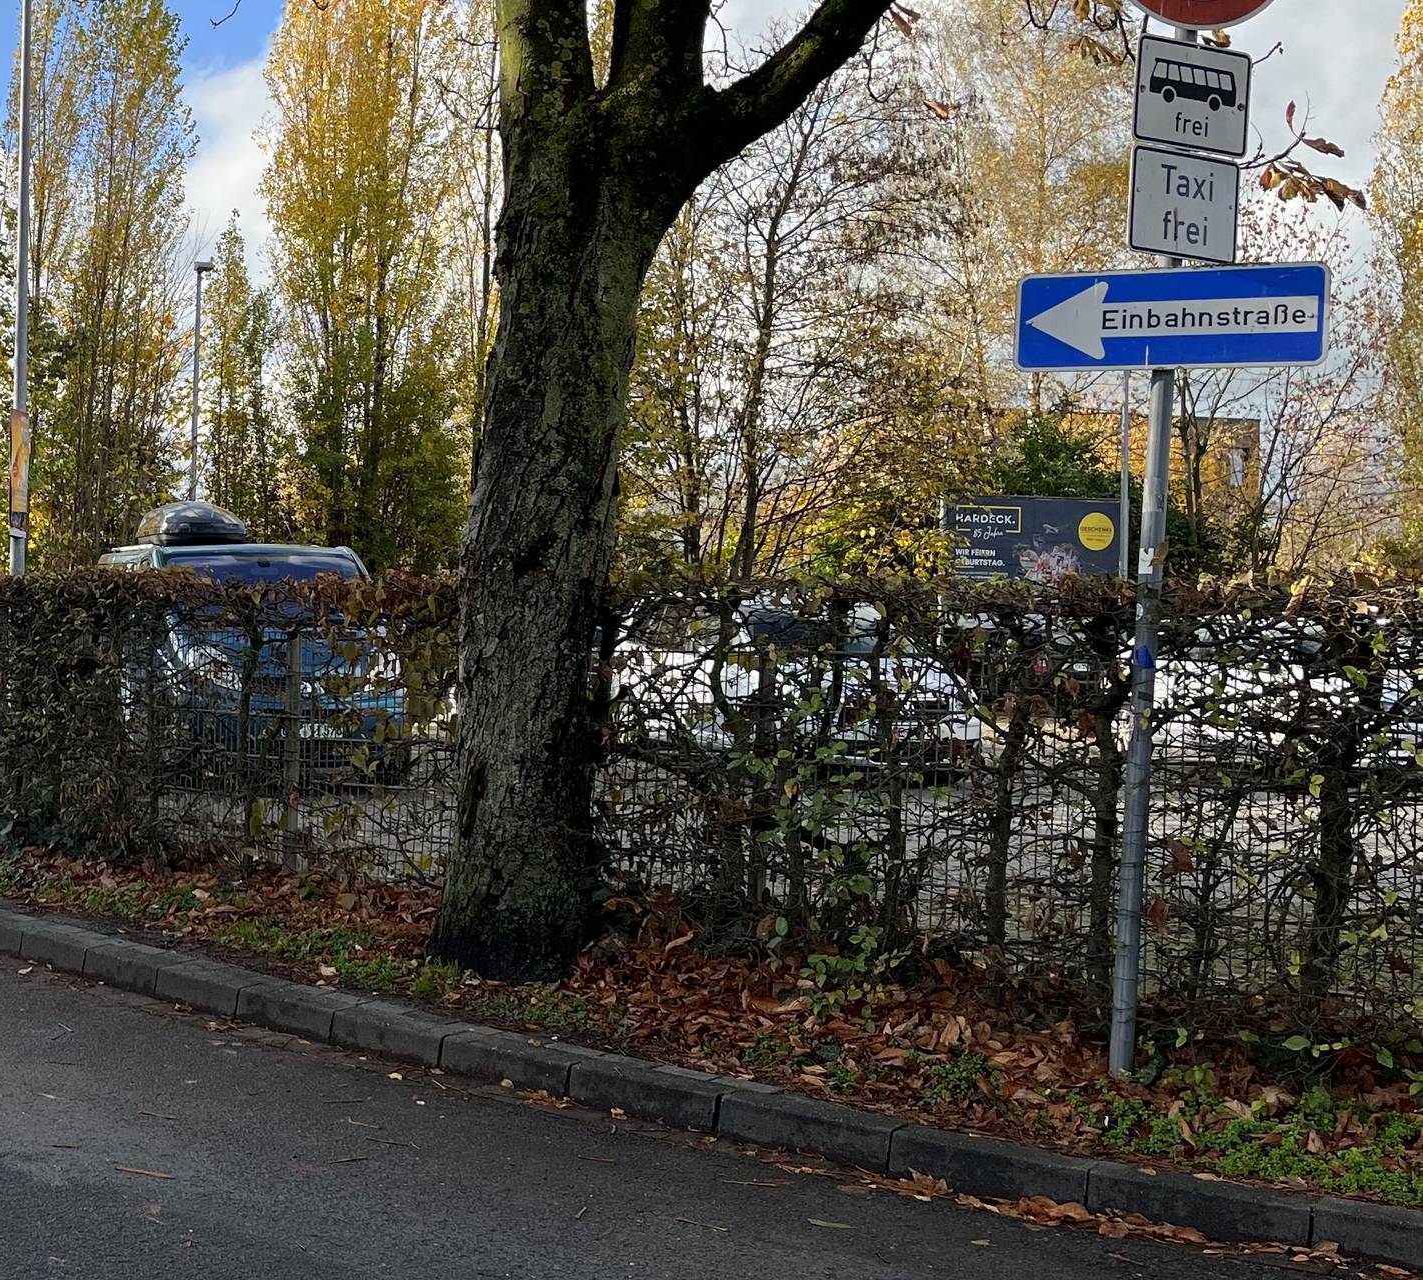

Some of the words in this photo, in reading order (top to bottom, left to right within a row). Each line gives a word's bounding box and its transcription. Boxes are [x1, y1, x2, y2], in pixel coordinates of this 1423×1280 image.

[1174, 111, 1210, 138] frei
[1160, 164, 1215, 203] Taxi
[1161, 211, 1209, 247] frei
[1101, 304, 1308, 331] Einbahnstraße
[956, 513, 1016, 525] HARDECK.
[955, 548, 970, 556] WIR
